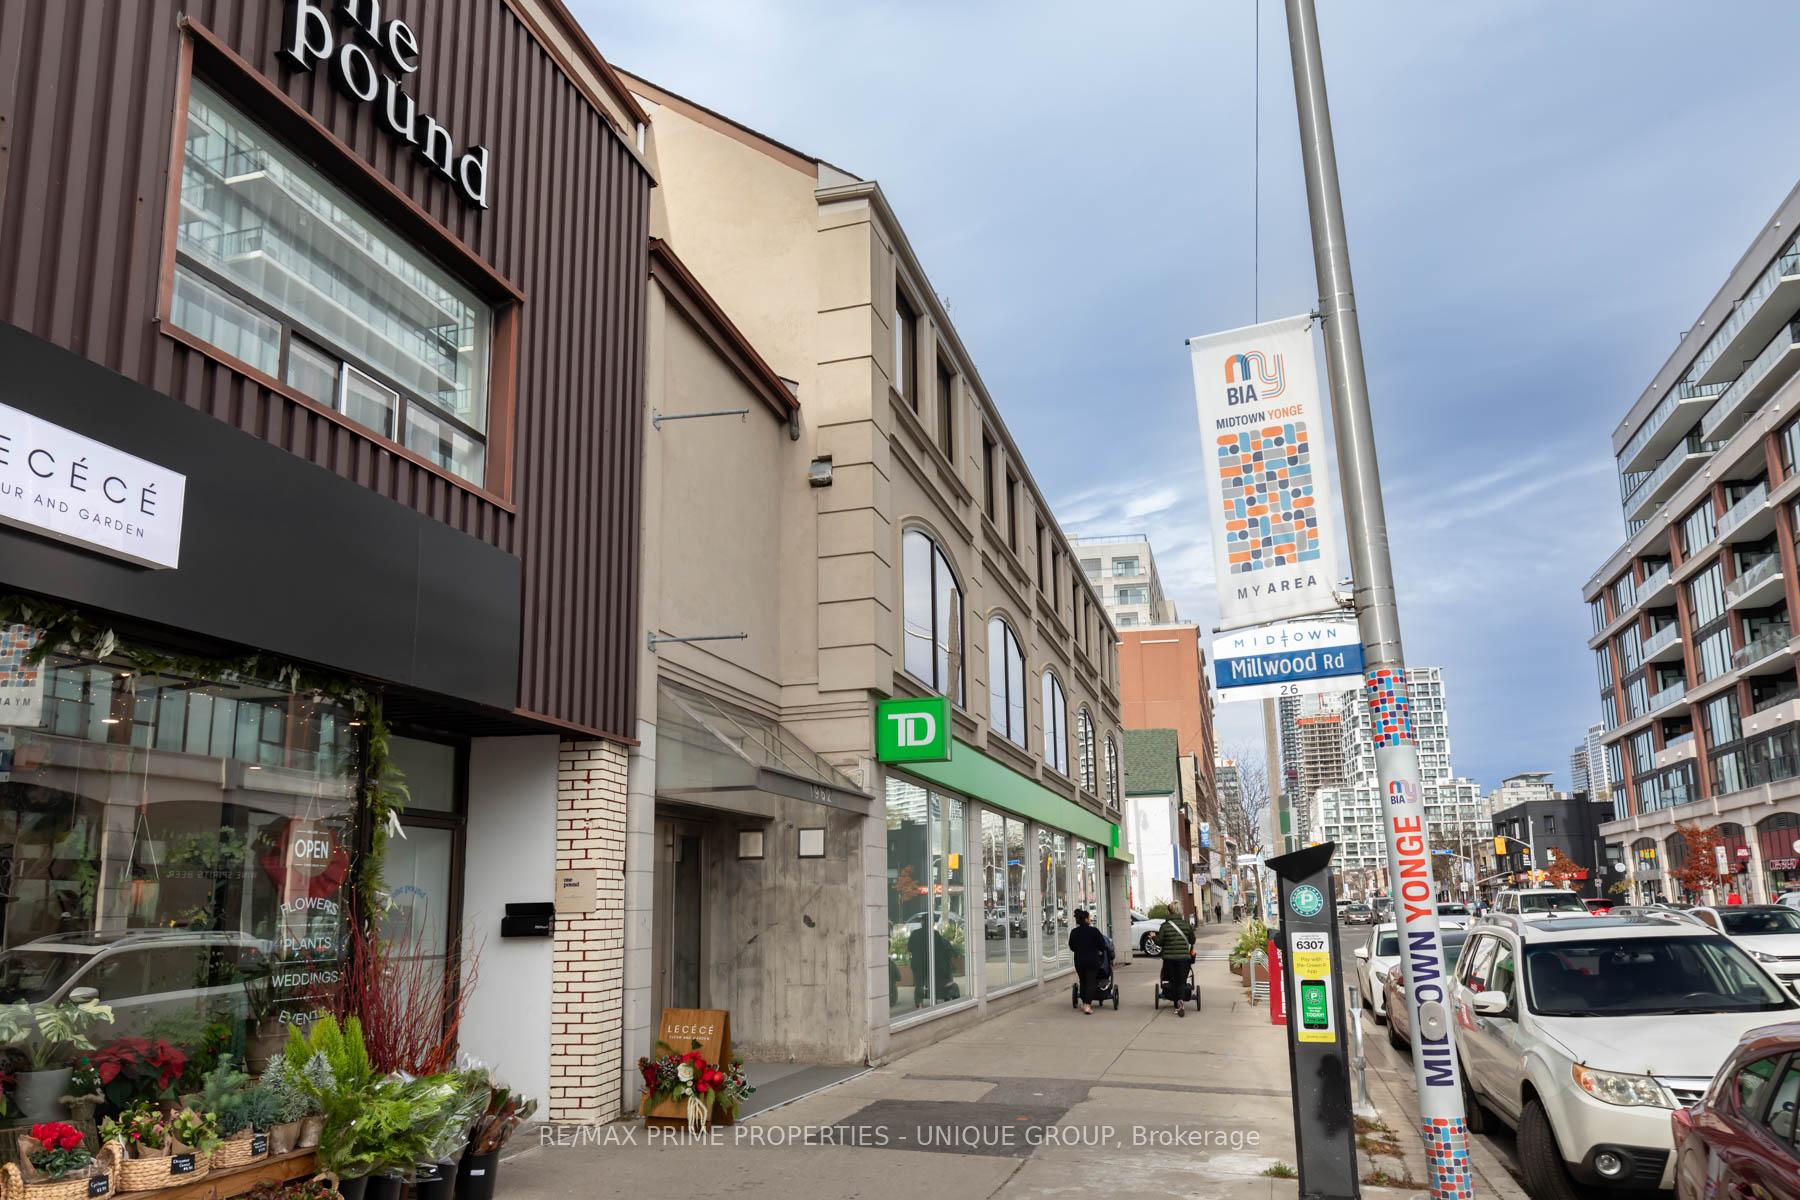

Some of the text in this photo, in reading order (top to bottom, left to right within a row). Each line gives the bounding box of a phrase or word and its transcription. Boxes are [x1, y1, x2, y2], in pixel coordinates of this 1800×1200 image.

[287, 0, 489, 209] pound
[1226, 384, 1258, 406] BIA
[1216, 404, 1305, 430] MIDTOWN YONGE
[34, 494, 69, 513] AND
[78, 508, 145, 538] GARDEN
[1234, 628, 1337, 649] MIDTOWN
[1231, 652, 1345, 680] Millwood Rd
[1280, 684, 1299, 696] 26
[887, 712, 936, 747] TD
[1390, 795, 1406, 805] BIA
[295, 839, 329, 859] OPEN
[1392, 815, 1433, 924] YONGE
[280, 897, 340, 916] FLOWERS
[283, 937, 332, 951] PLANTS
[1296, 941, 1325, 950] 6307
[271, 970, 339, 988] WEDDINGS
[1407, 931, 1454, 1087] MIOWN
